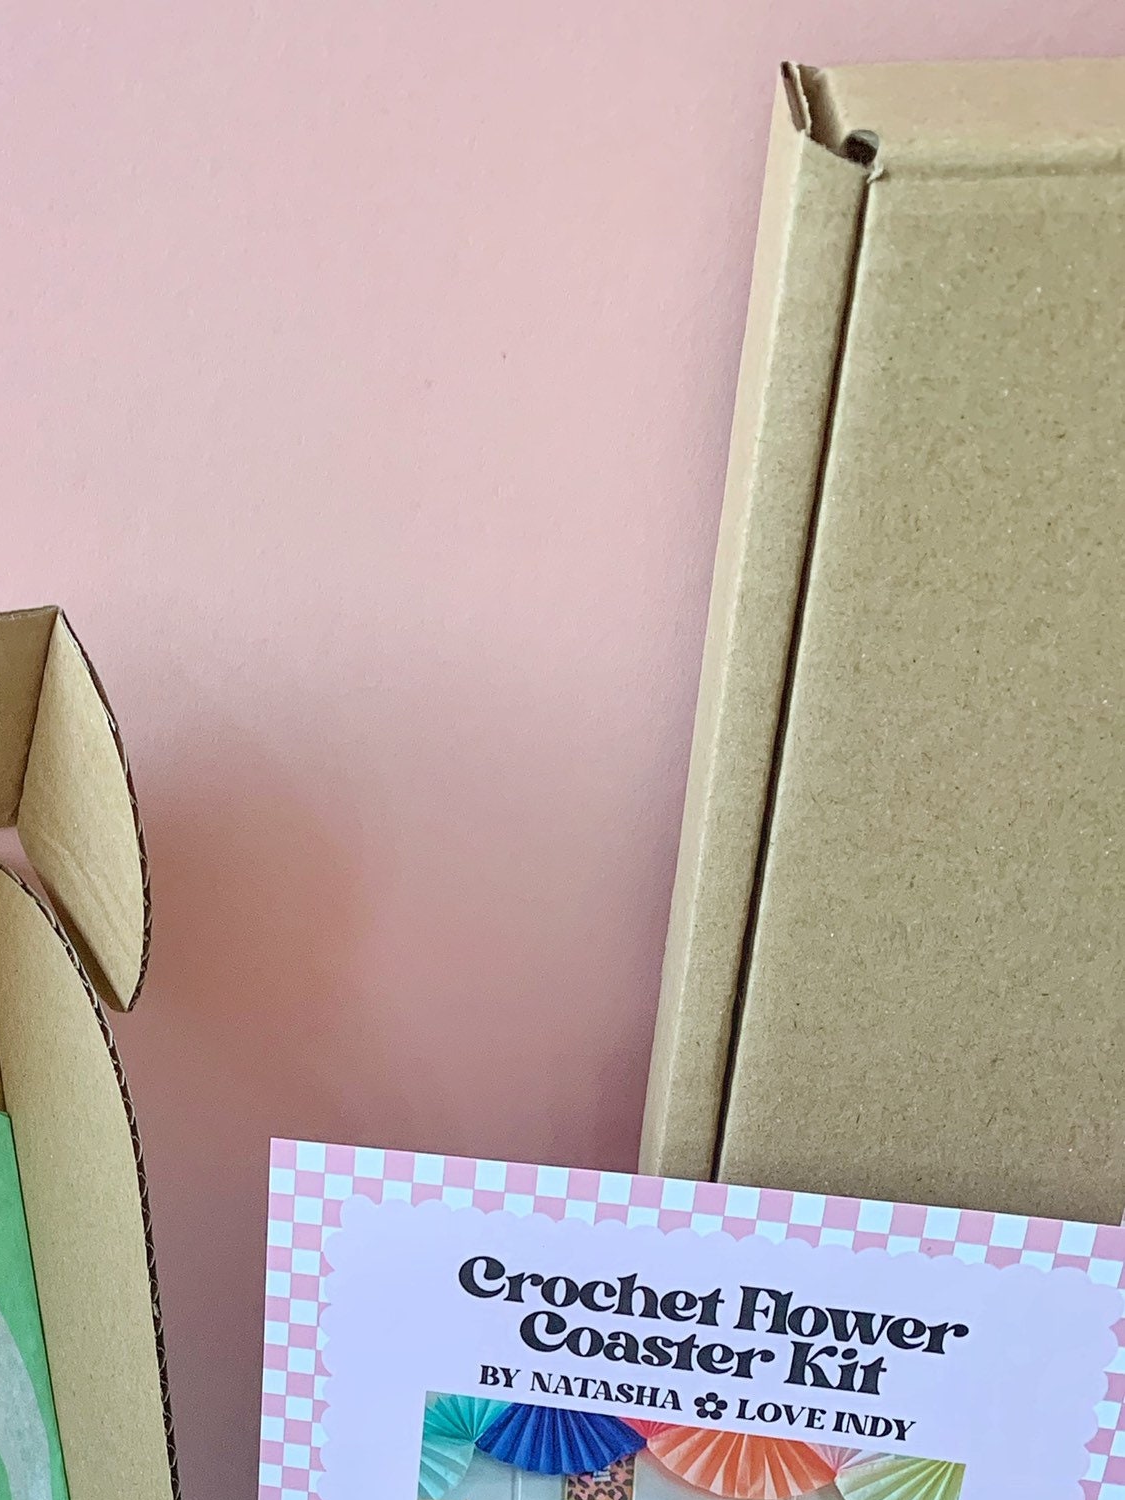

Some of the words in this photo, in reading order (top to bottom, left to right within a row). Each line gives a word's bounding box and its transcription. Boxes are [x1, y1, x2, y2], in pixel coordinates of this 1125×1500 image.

[458, 1255, 725, 1327] Crochet
[733, 1285, 970, 1355] Flower
[519, 1310, 776, 1380] Coaster
[783, 1340, 888, 1396] Kit
[479, 1364, 522, 1389] BY
[529, 1370, 683, 1412] NATASHA
[735, 1398, 827, 1431] LOVE
[831, 1410, 917, 1442] INDY
